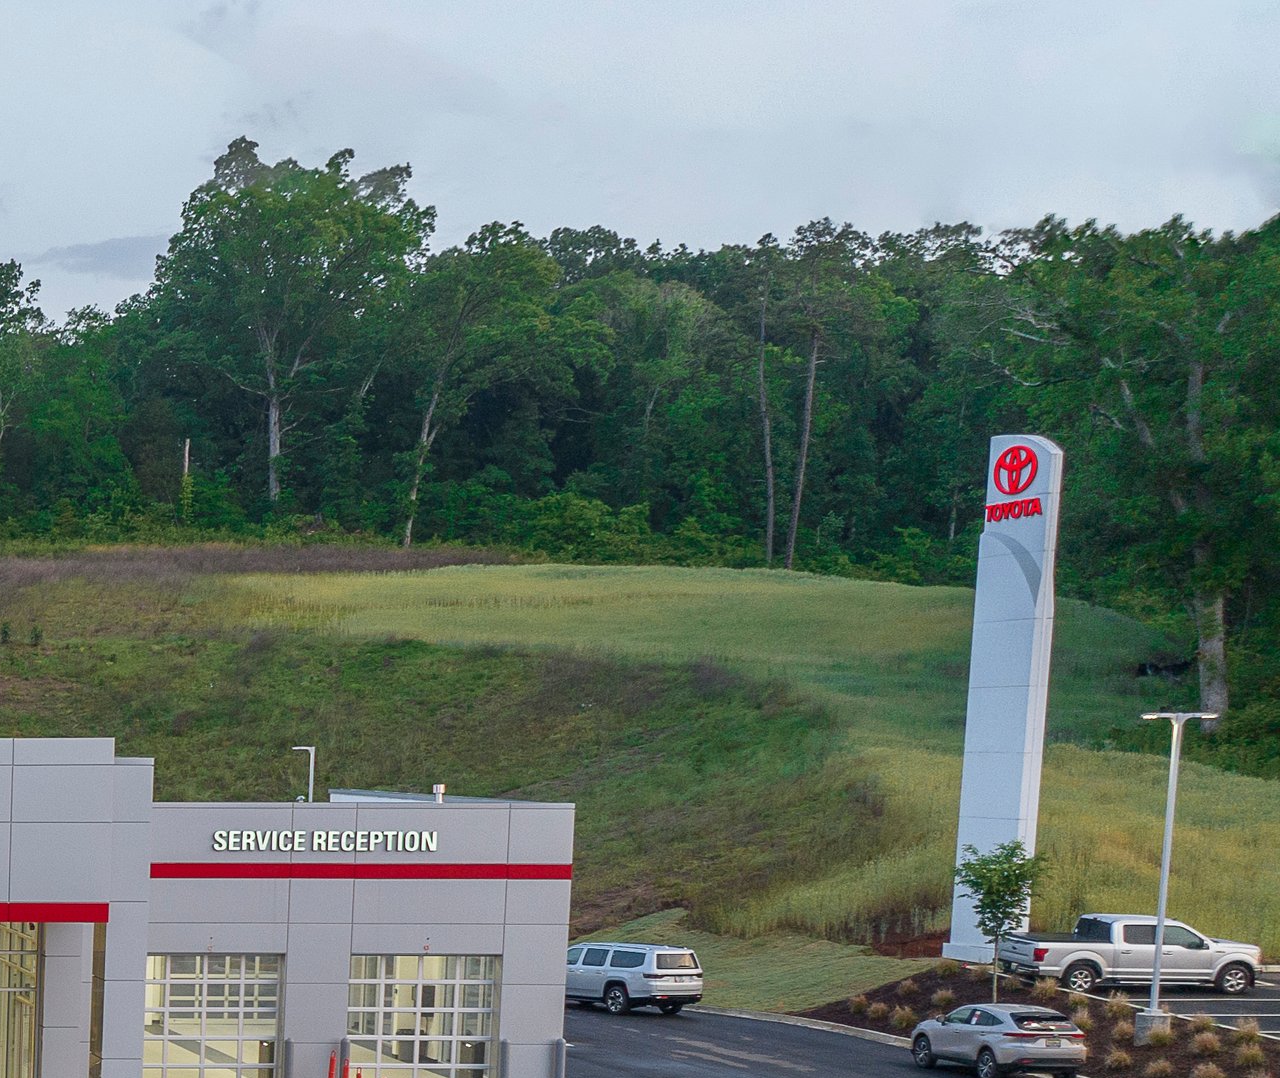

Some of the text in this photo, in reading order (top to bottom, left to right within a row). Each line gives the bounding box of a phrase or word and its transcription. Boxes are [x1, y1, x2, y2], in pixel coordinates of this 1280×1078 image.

[985, 497, 1042, 522] TOYOTA
[213, 830, 438, 851] SERVICE RECEPTION
